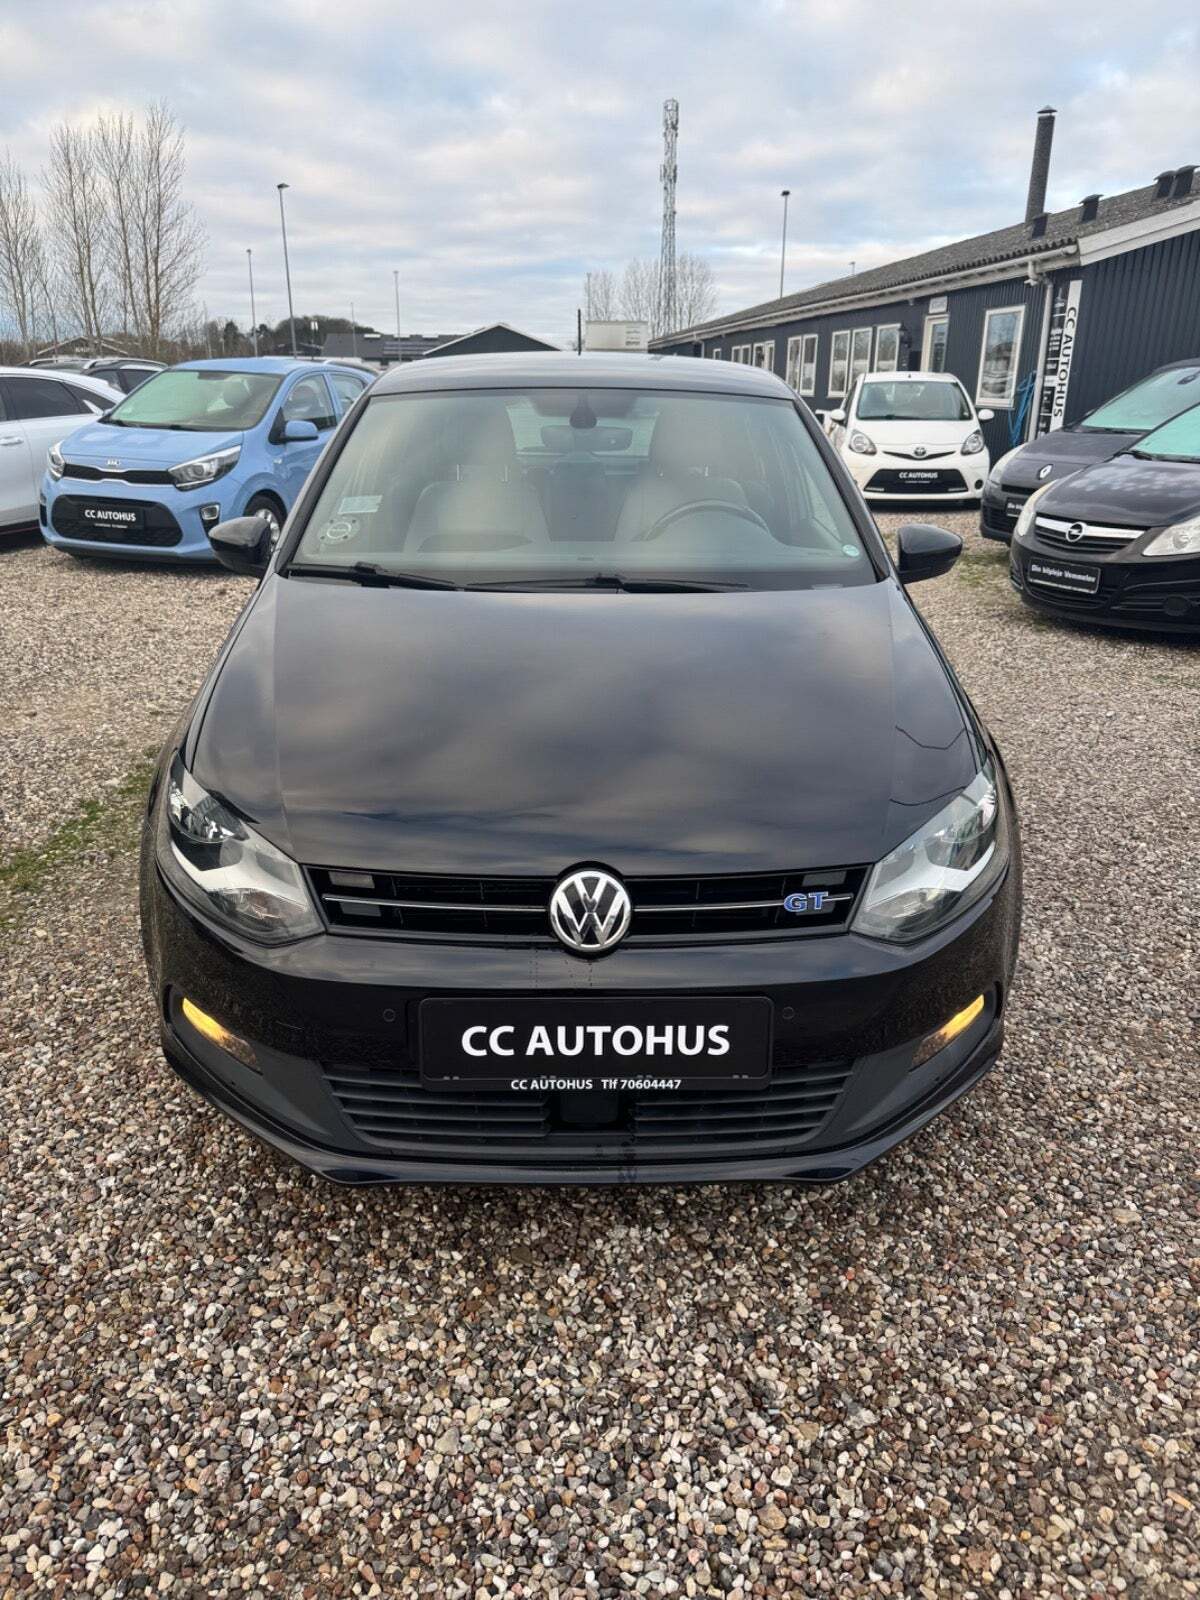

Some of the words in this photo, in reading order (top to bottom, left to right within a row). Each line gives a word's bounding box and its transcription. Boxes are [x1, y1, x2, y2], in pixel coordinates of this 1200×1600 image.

[1065, 306, 1077, 332] CC
[1053, 334, 1074, 417] AUTOHUS
[84, 509, 95, 518] CC
[97, 510, 136, 522] AUTOHUS
[783, 891, 829, 913] GT
[461, 1025, 515, 1057] CC
[525, 1025, 730, 1057] AUTOHUS
[511, 1079, 528, 1090] CC
[530, 1079, 593, 1090] AUTOHUS
[601, 1079, 617, 1090] Tlf
[620, 1079, 682, 1090] 70604447
